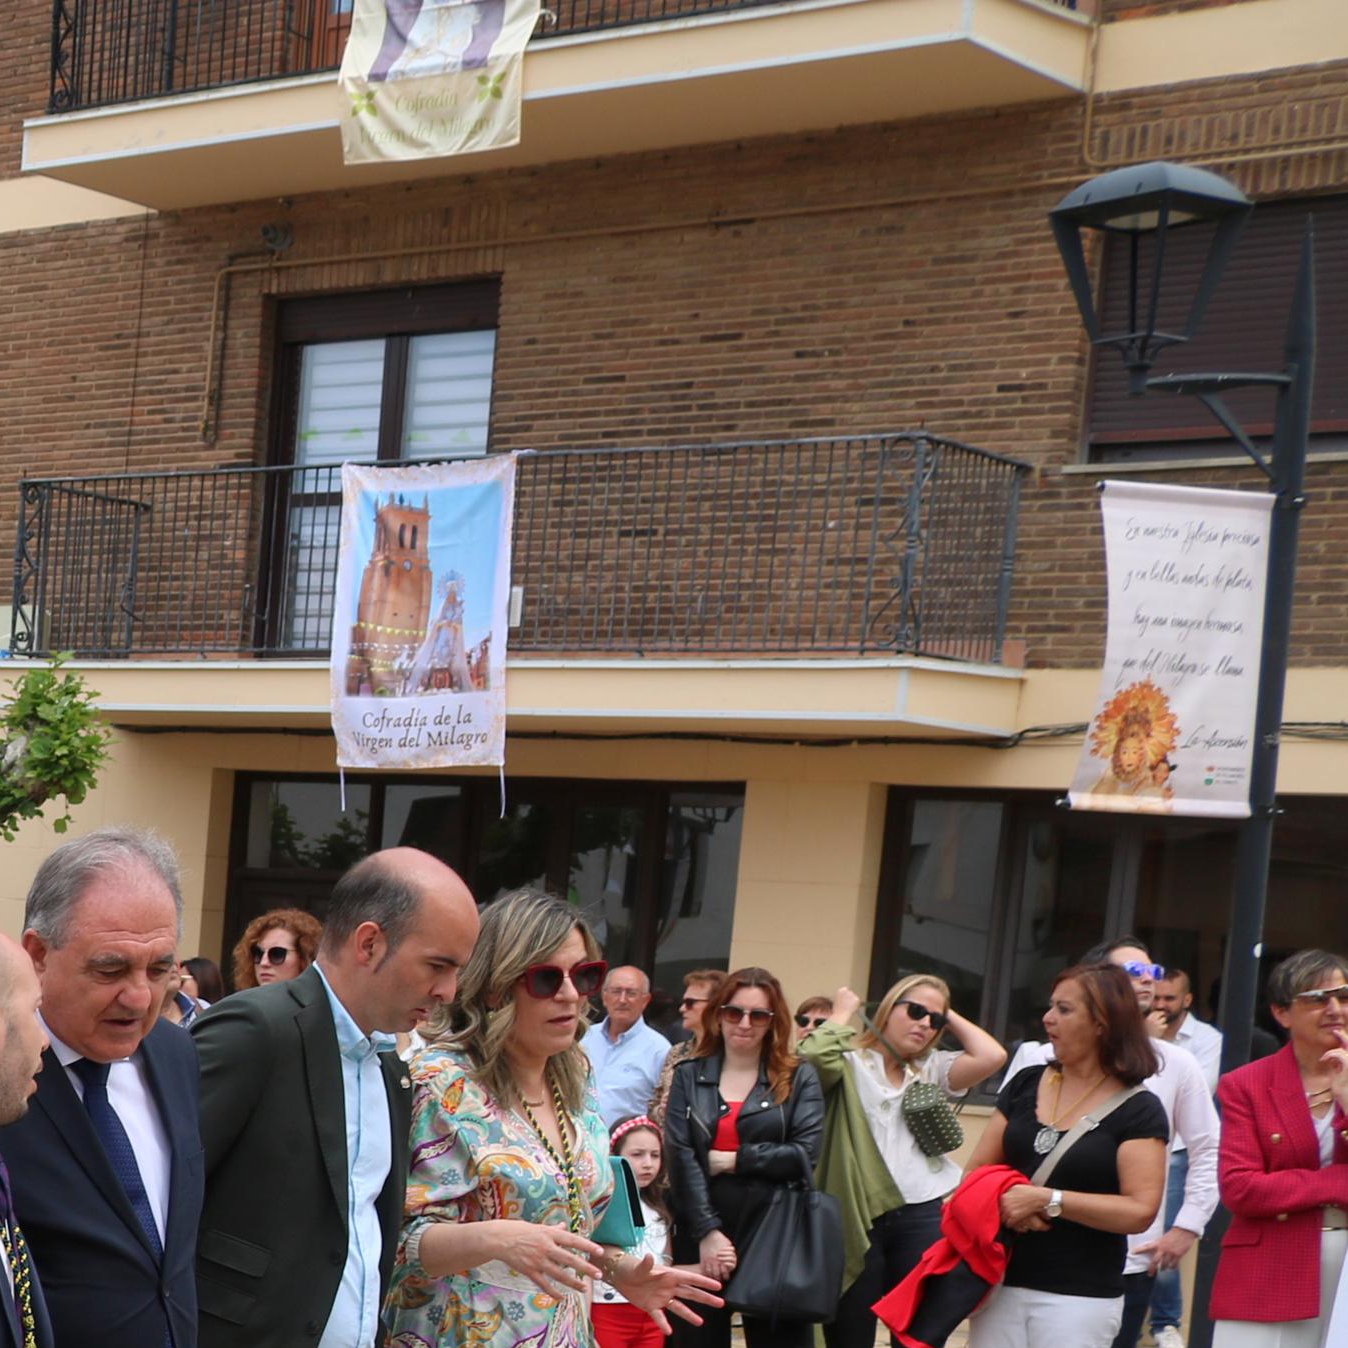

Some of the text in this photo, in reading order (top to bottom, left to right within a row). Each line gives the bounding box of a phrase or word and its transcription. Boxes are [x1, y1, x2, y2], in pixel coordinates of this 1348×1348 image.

[362, 703, 473, 733] Cofradía de la
[398, 728, 422, 748] del
[426, 726, 488, 750] Milagro
